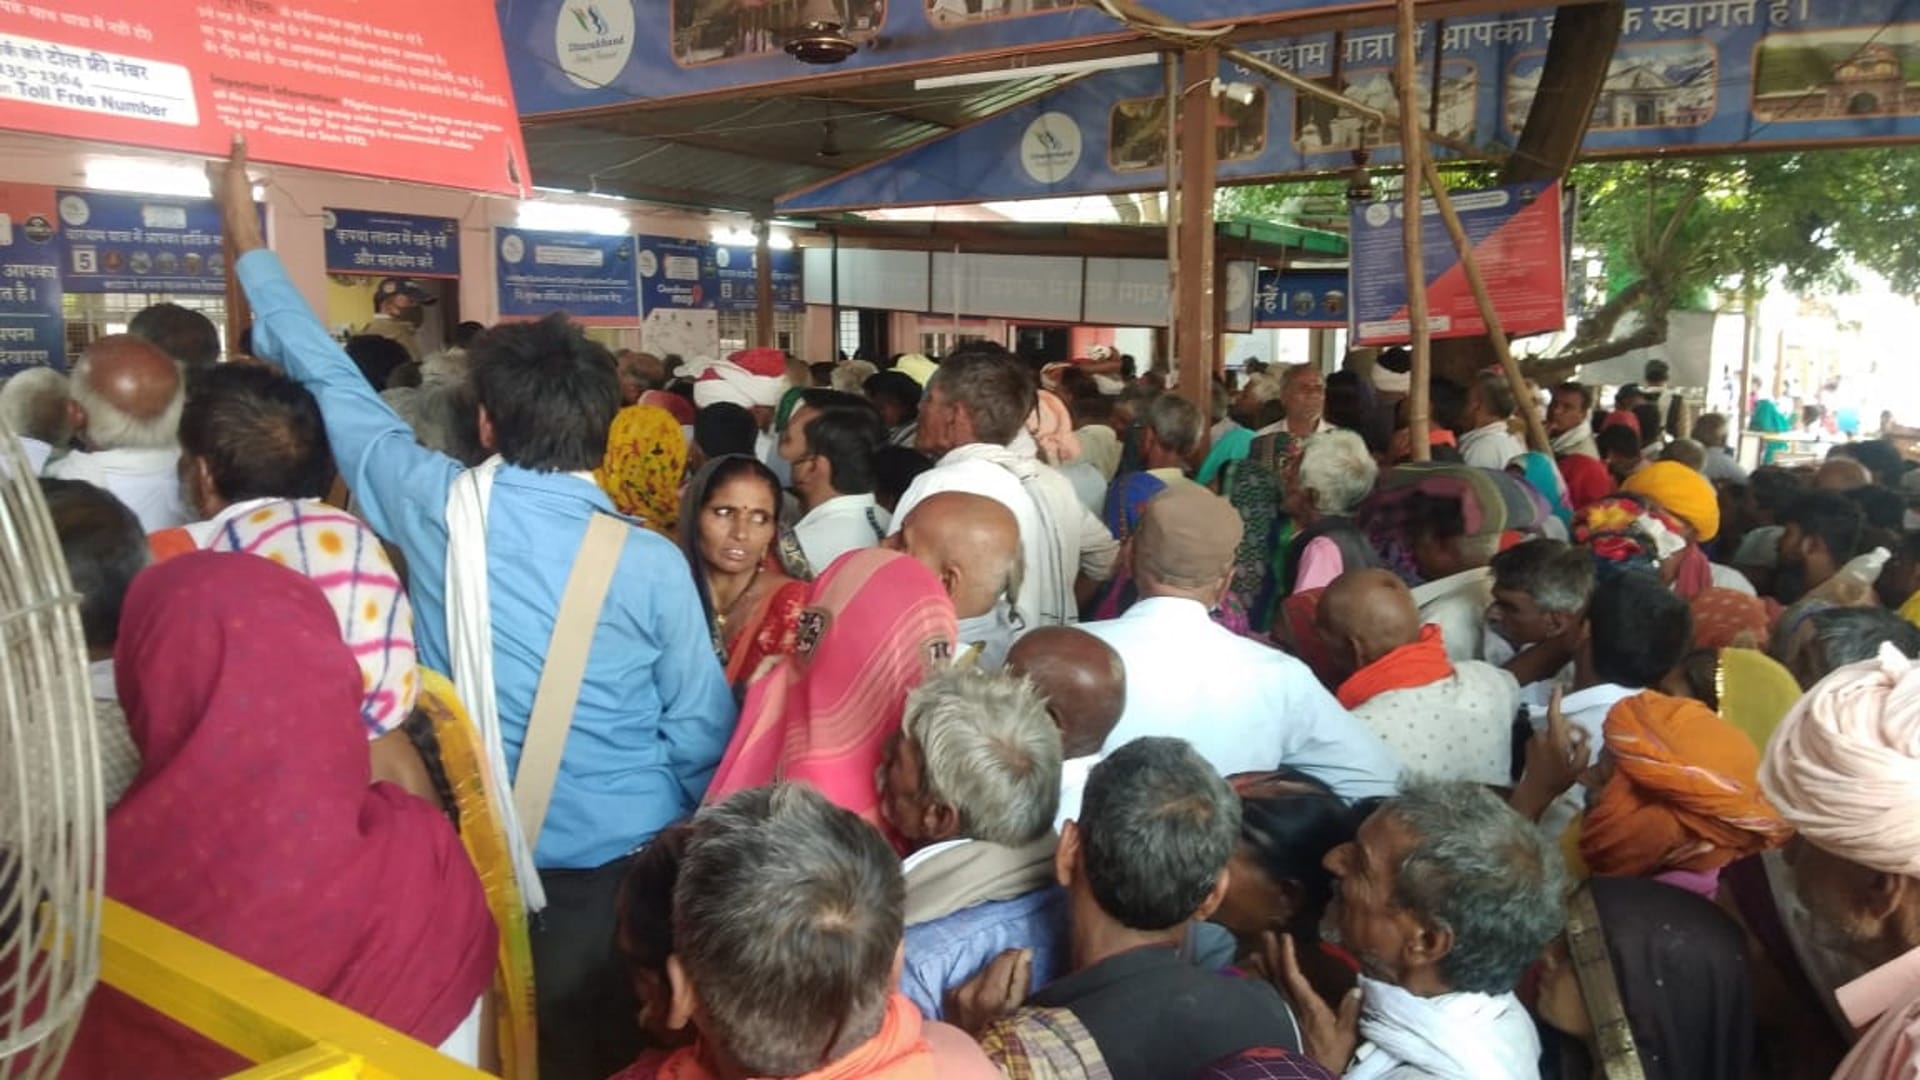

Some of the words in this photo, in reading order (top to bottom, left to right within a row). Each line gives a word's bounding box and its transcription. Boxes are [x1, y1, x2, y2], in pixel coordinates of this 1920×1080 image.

[1652, 0, 1757, 31] स्वागत
[45, 45, 82, 69] टोल
[112, 58, 149, 80] नंबर
[14, 81, 51, 100] Toll
[56, 88, 96, 107] Free
[101, 95, 168, 117] Number
[3, 264, 58, 280] आपका
[80, 253, 90, 270] 5
